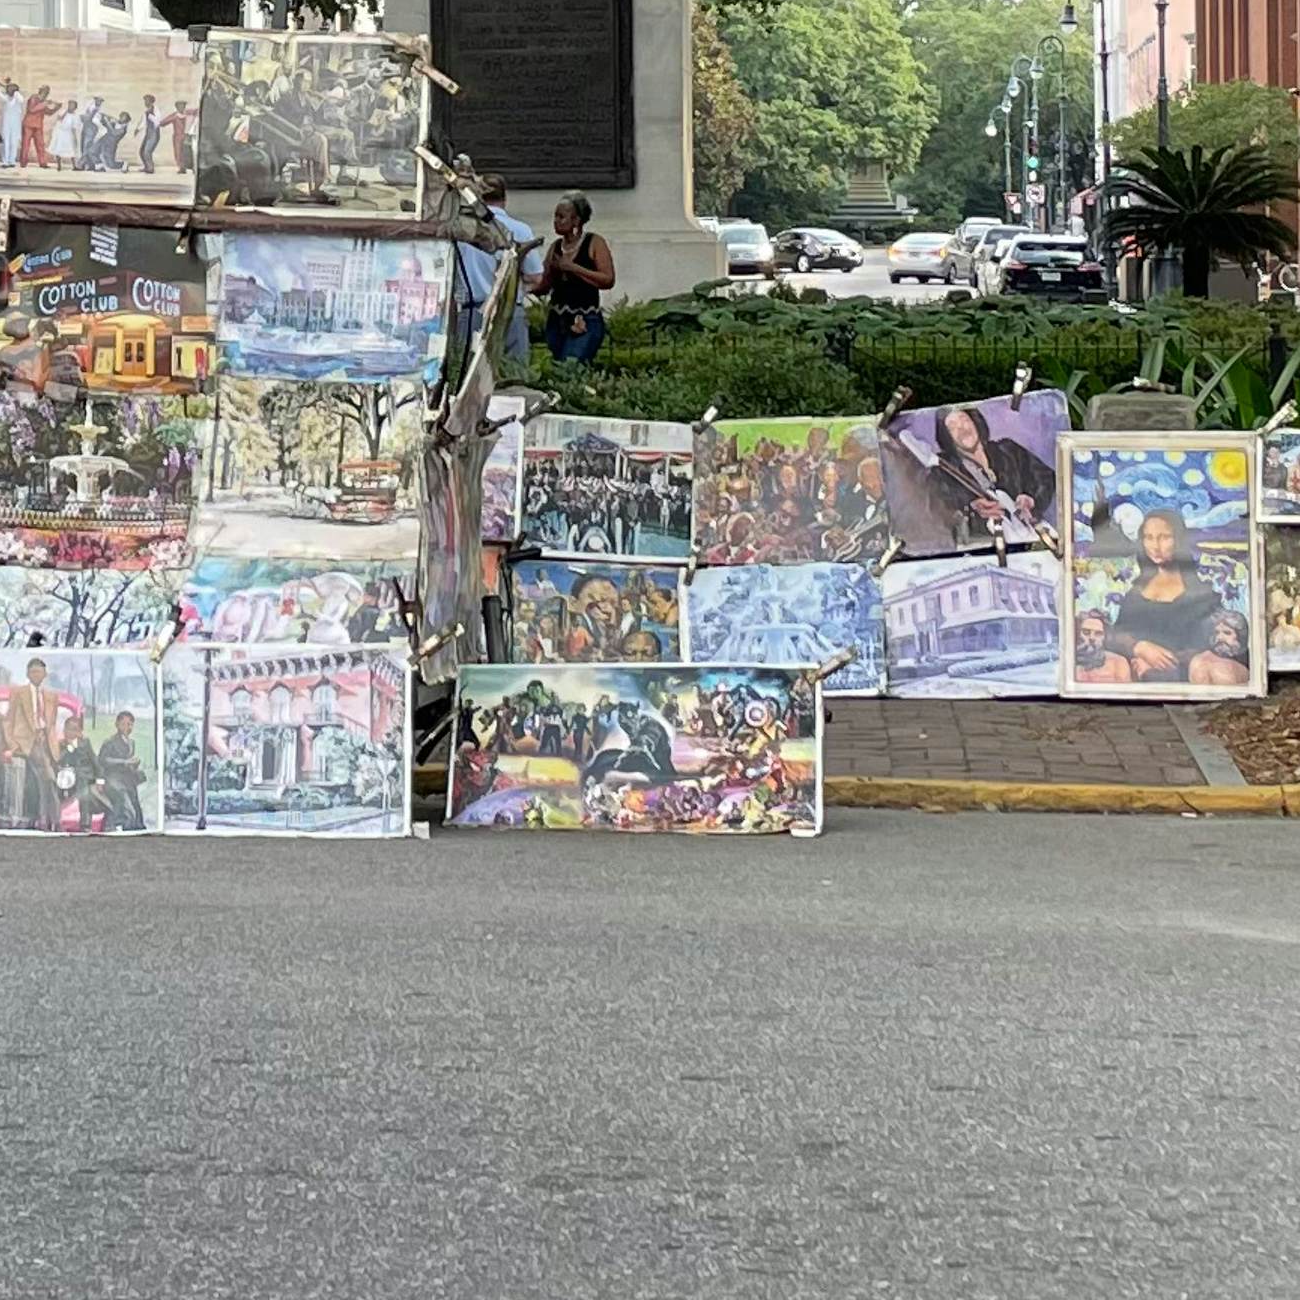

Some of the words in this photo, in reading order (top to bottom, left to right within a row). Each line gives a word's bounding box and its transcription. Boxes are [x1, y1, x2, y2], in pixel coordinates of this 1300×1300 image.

[39, 279, 97, 315] COTTON
[80, 295, 119, 312] CLUB
[132, 276, 181, 311] COTTON
[153, 300, 181, 317] CLUB
